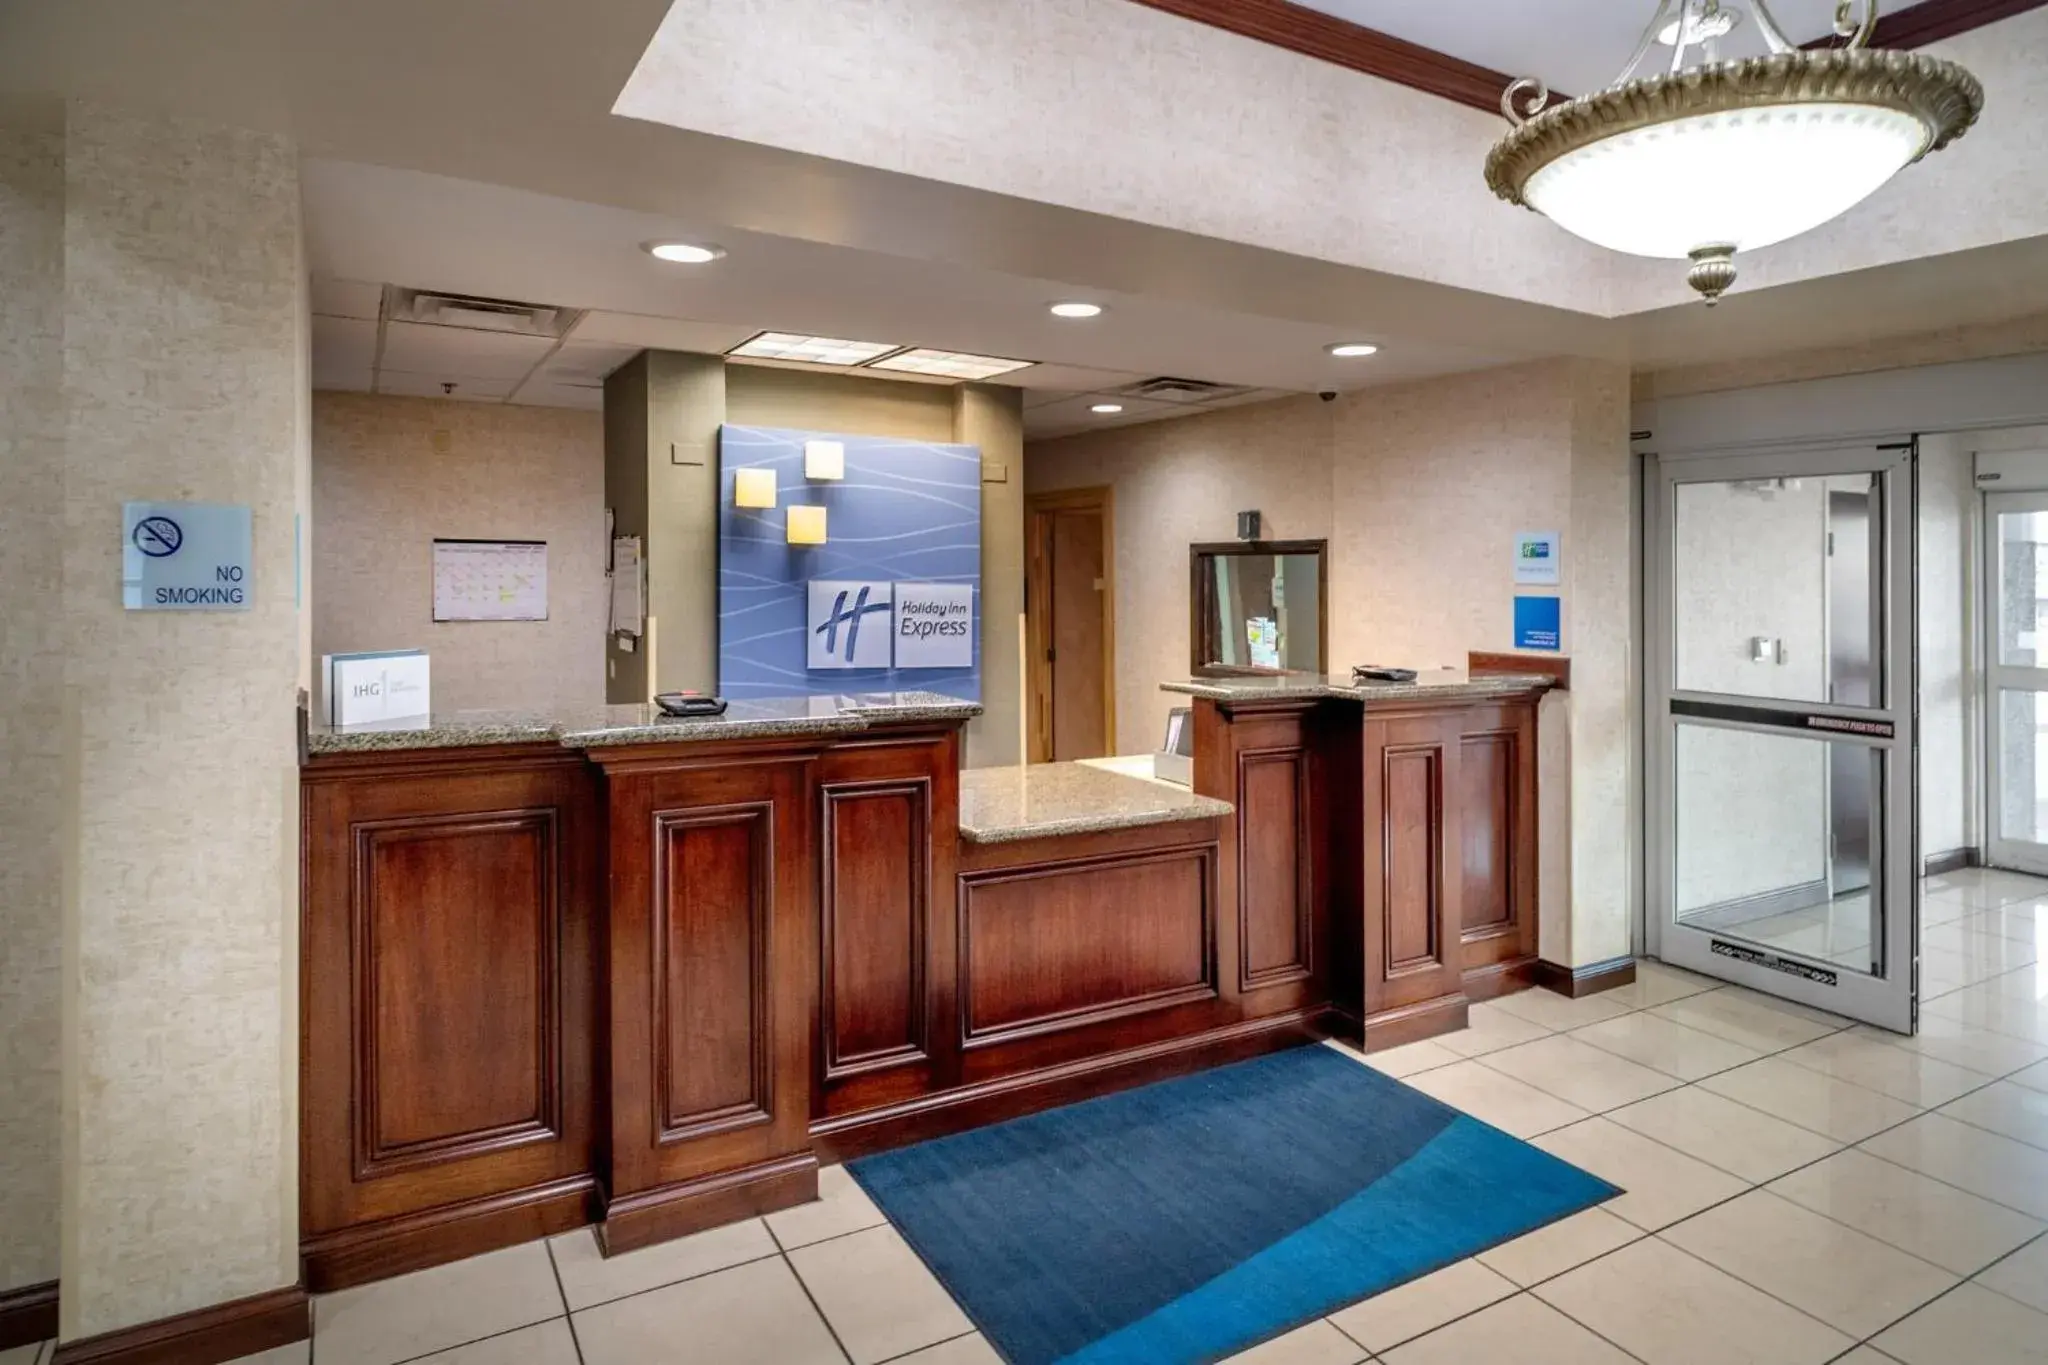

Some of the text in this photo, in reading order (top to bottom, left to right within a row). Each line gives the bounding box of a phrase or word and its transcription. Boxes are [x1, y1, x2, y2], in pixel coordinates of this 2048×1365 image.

[216, 566, 243, 582] NO
[155, 588, 243, 604] SMOKING
[902, 601, 966, 616] Holiday Inn
[901, 618, 967, 640] Express
[353, 683, 380, 697] IHG
